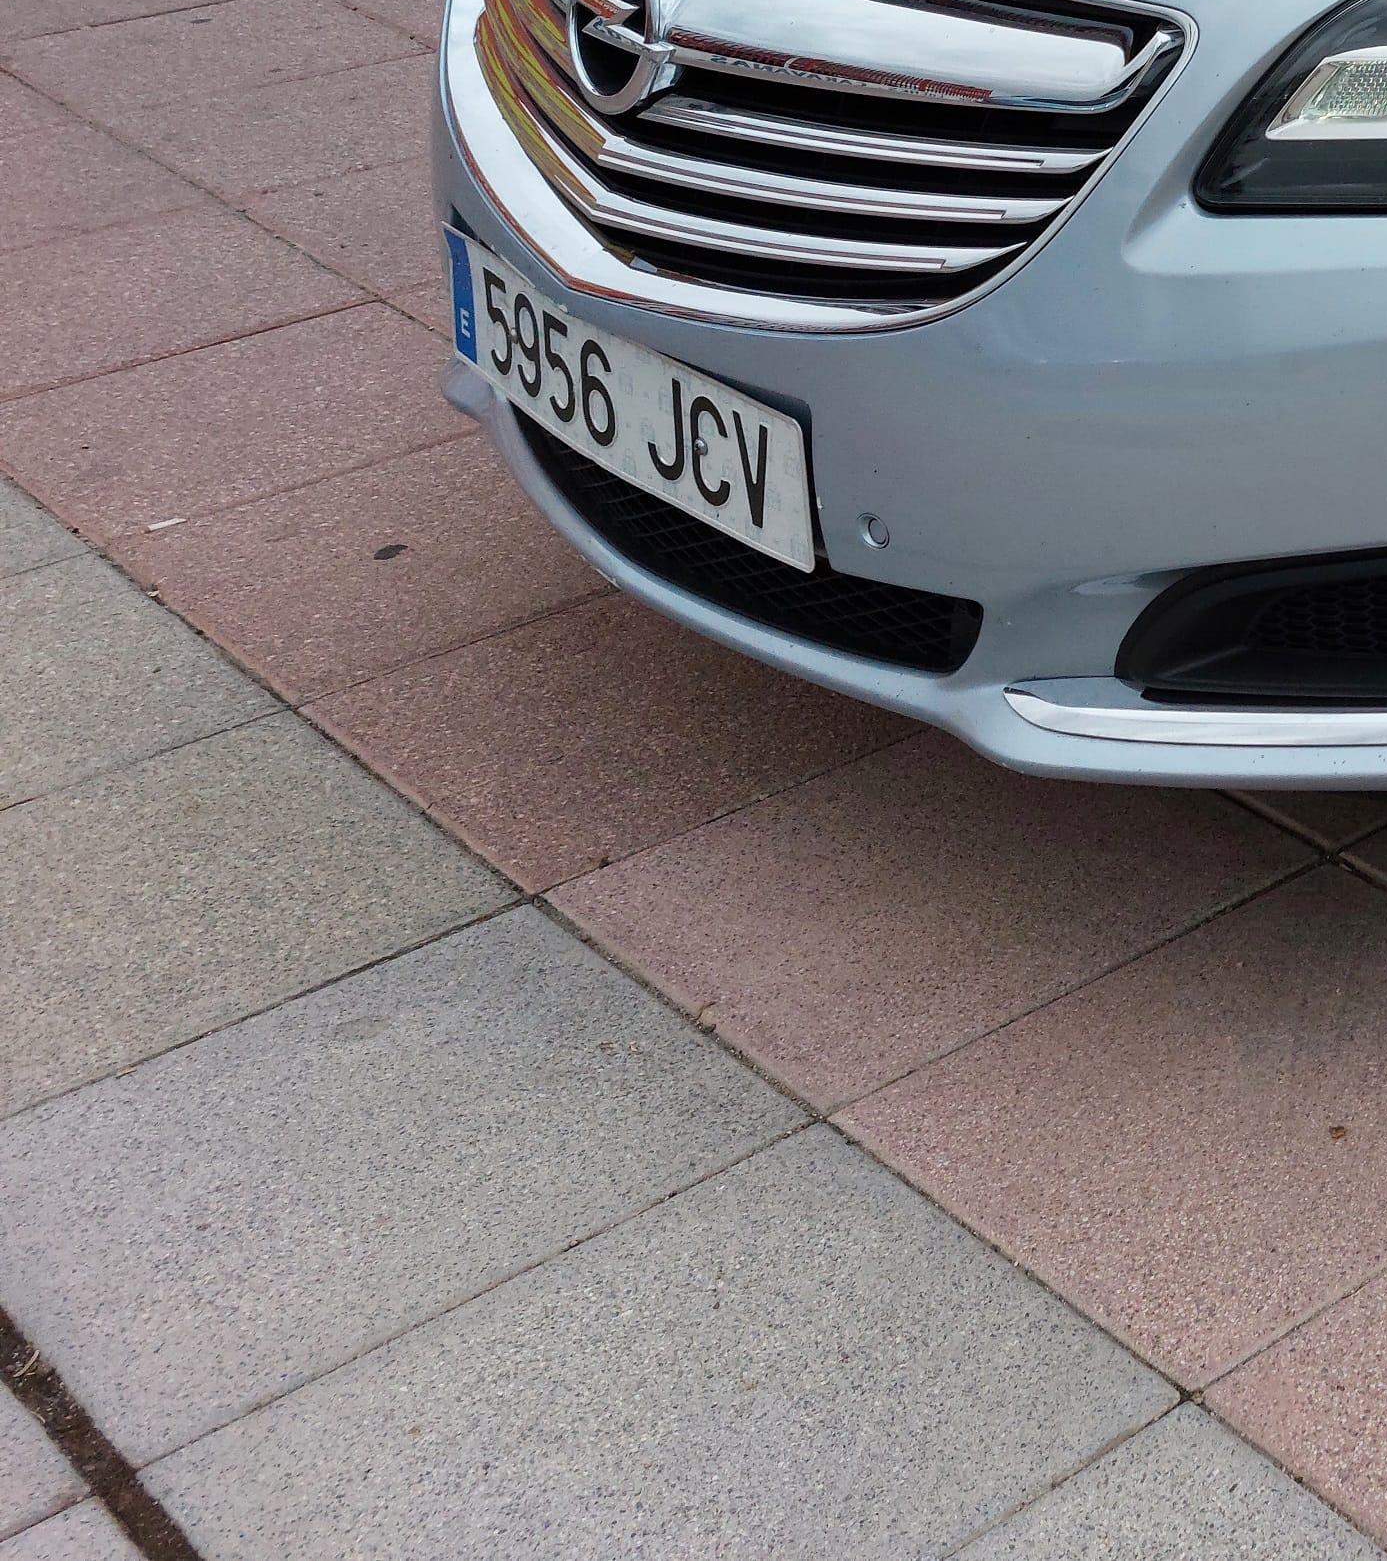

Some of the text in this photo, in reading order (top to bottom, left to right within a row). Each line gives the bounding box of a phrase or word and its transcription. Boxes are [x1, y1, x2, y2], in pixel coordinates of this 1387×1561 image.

[459, 308, 471, 339] E
[483, 267, 768, 529] 5956 JCV
